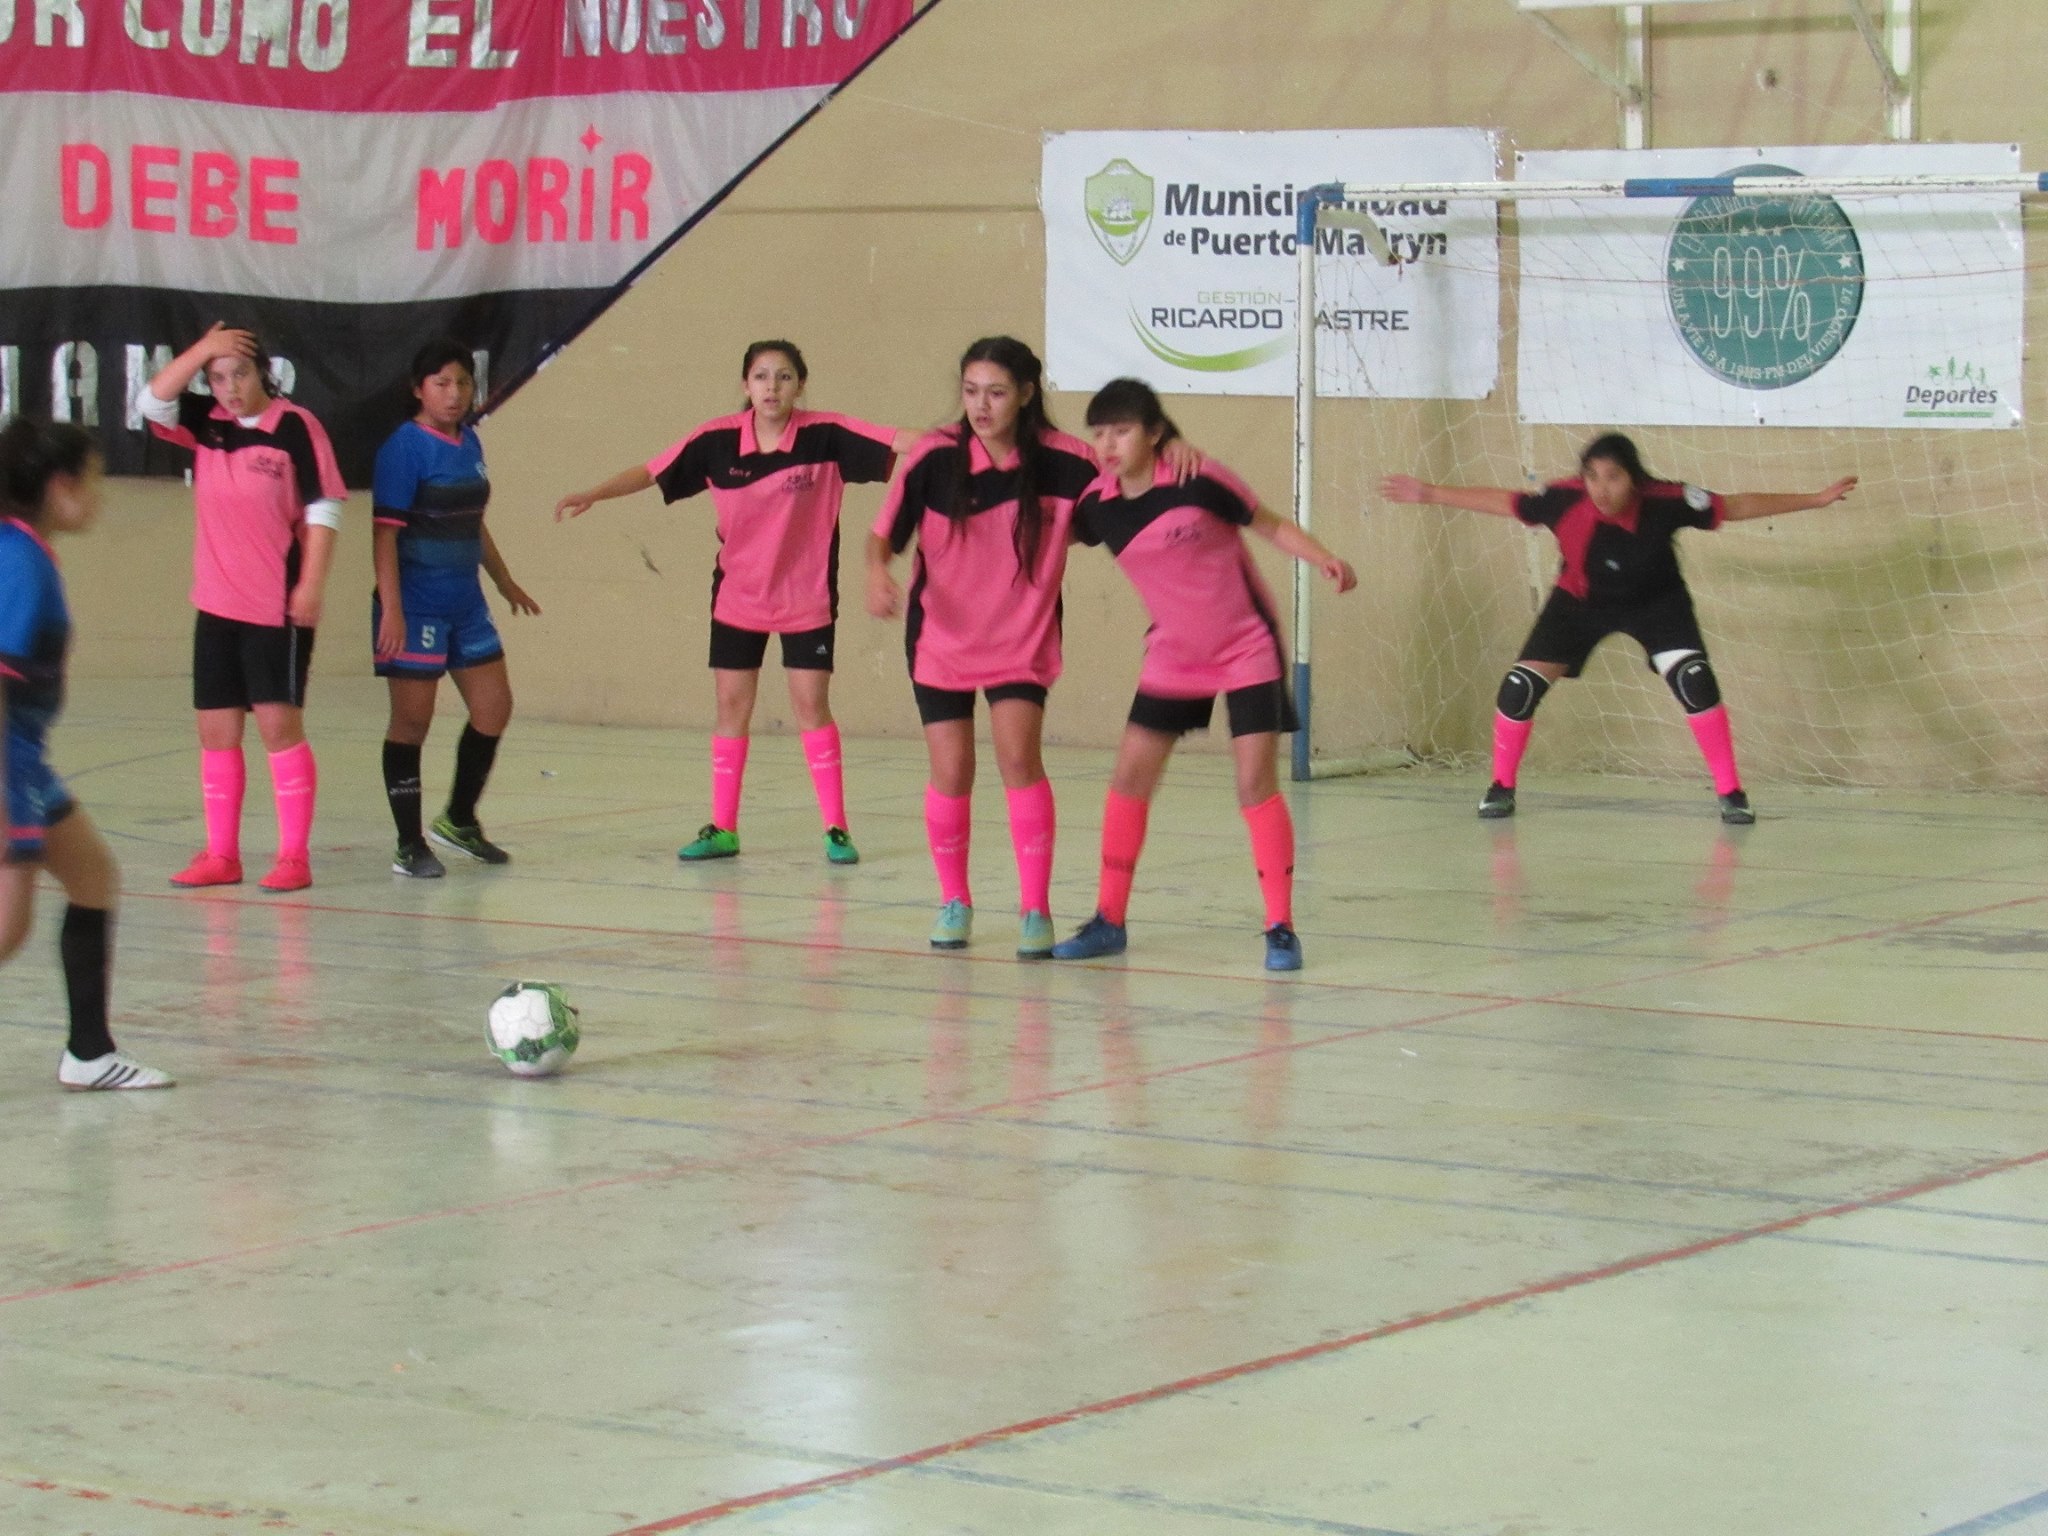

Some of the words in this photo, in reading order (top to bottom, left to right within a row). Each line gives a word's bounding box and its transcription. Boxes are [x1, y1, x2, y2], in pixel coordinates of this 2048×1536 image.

[124, 0, 348, 72] COMO
[408, 0, 518, 69] EL
[60, 143, 300, 244] DEBE
[1164, 183, 1447, 216] Municia
[1163, 230, 1186, 246] de
[1191, 227, 1297, 255] Puerto
[1315, 226, 1447, 264] Maryn
[1713, 245, 1811, 341] 99%
[1151, 308, 1283, 329] RICARDO
[1296, 309, 1410, 330] ASTRE
[1906, 385, 1998, 410] Deportes
[421, 625, 436, 649] 5
